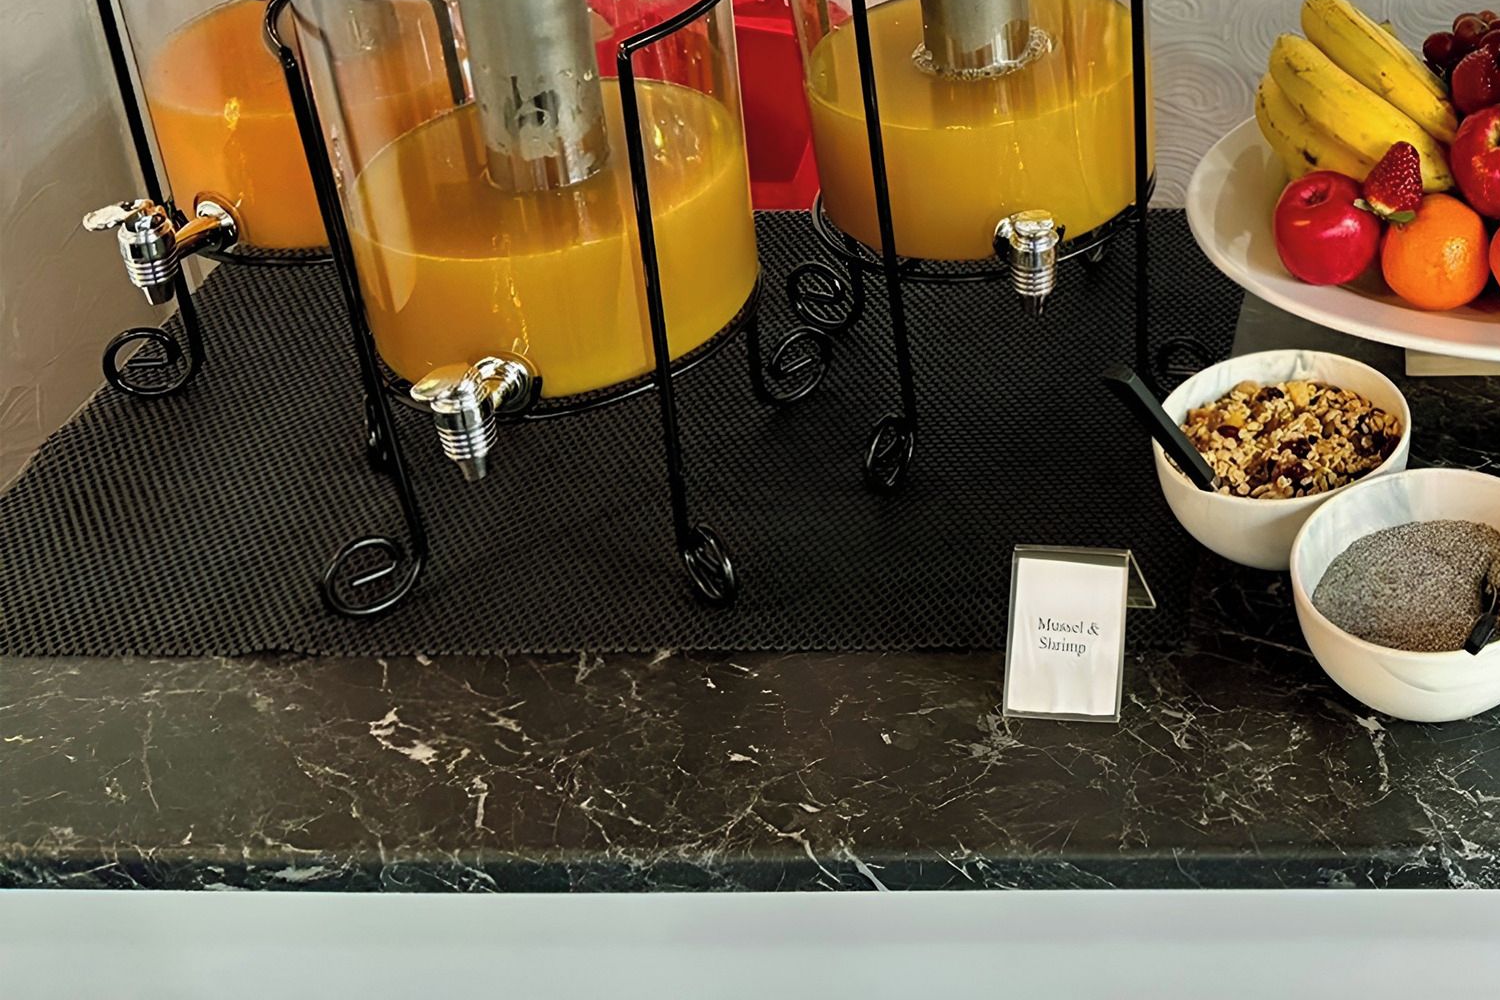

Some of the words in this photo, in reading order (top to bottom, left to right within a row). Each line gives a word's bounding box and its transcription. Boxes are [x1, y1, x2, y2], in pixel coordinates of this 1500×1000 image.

[1038, 616, 1084, 634] Mussel
[1087, 621, 1100, 636] &
[1038, 636, 1086, 657] Shrimp
